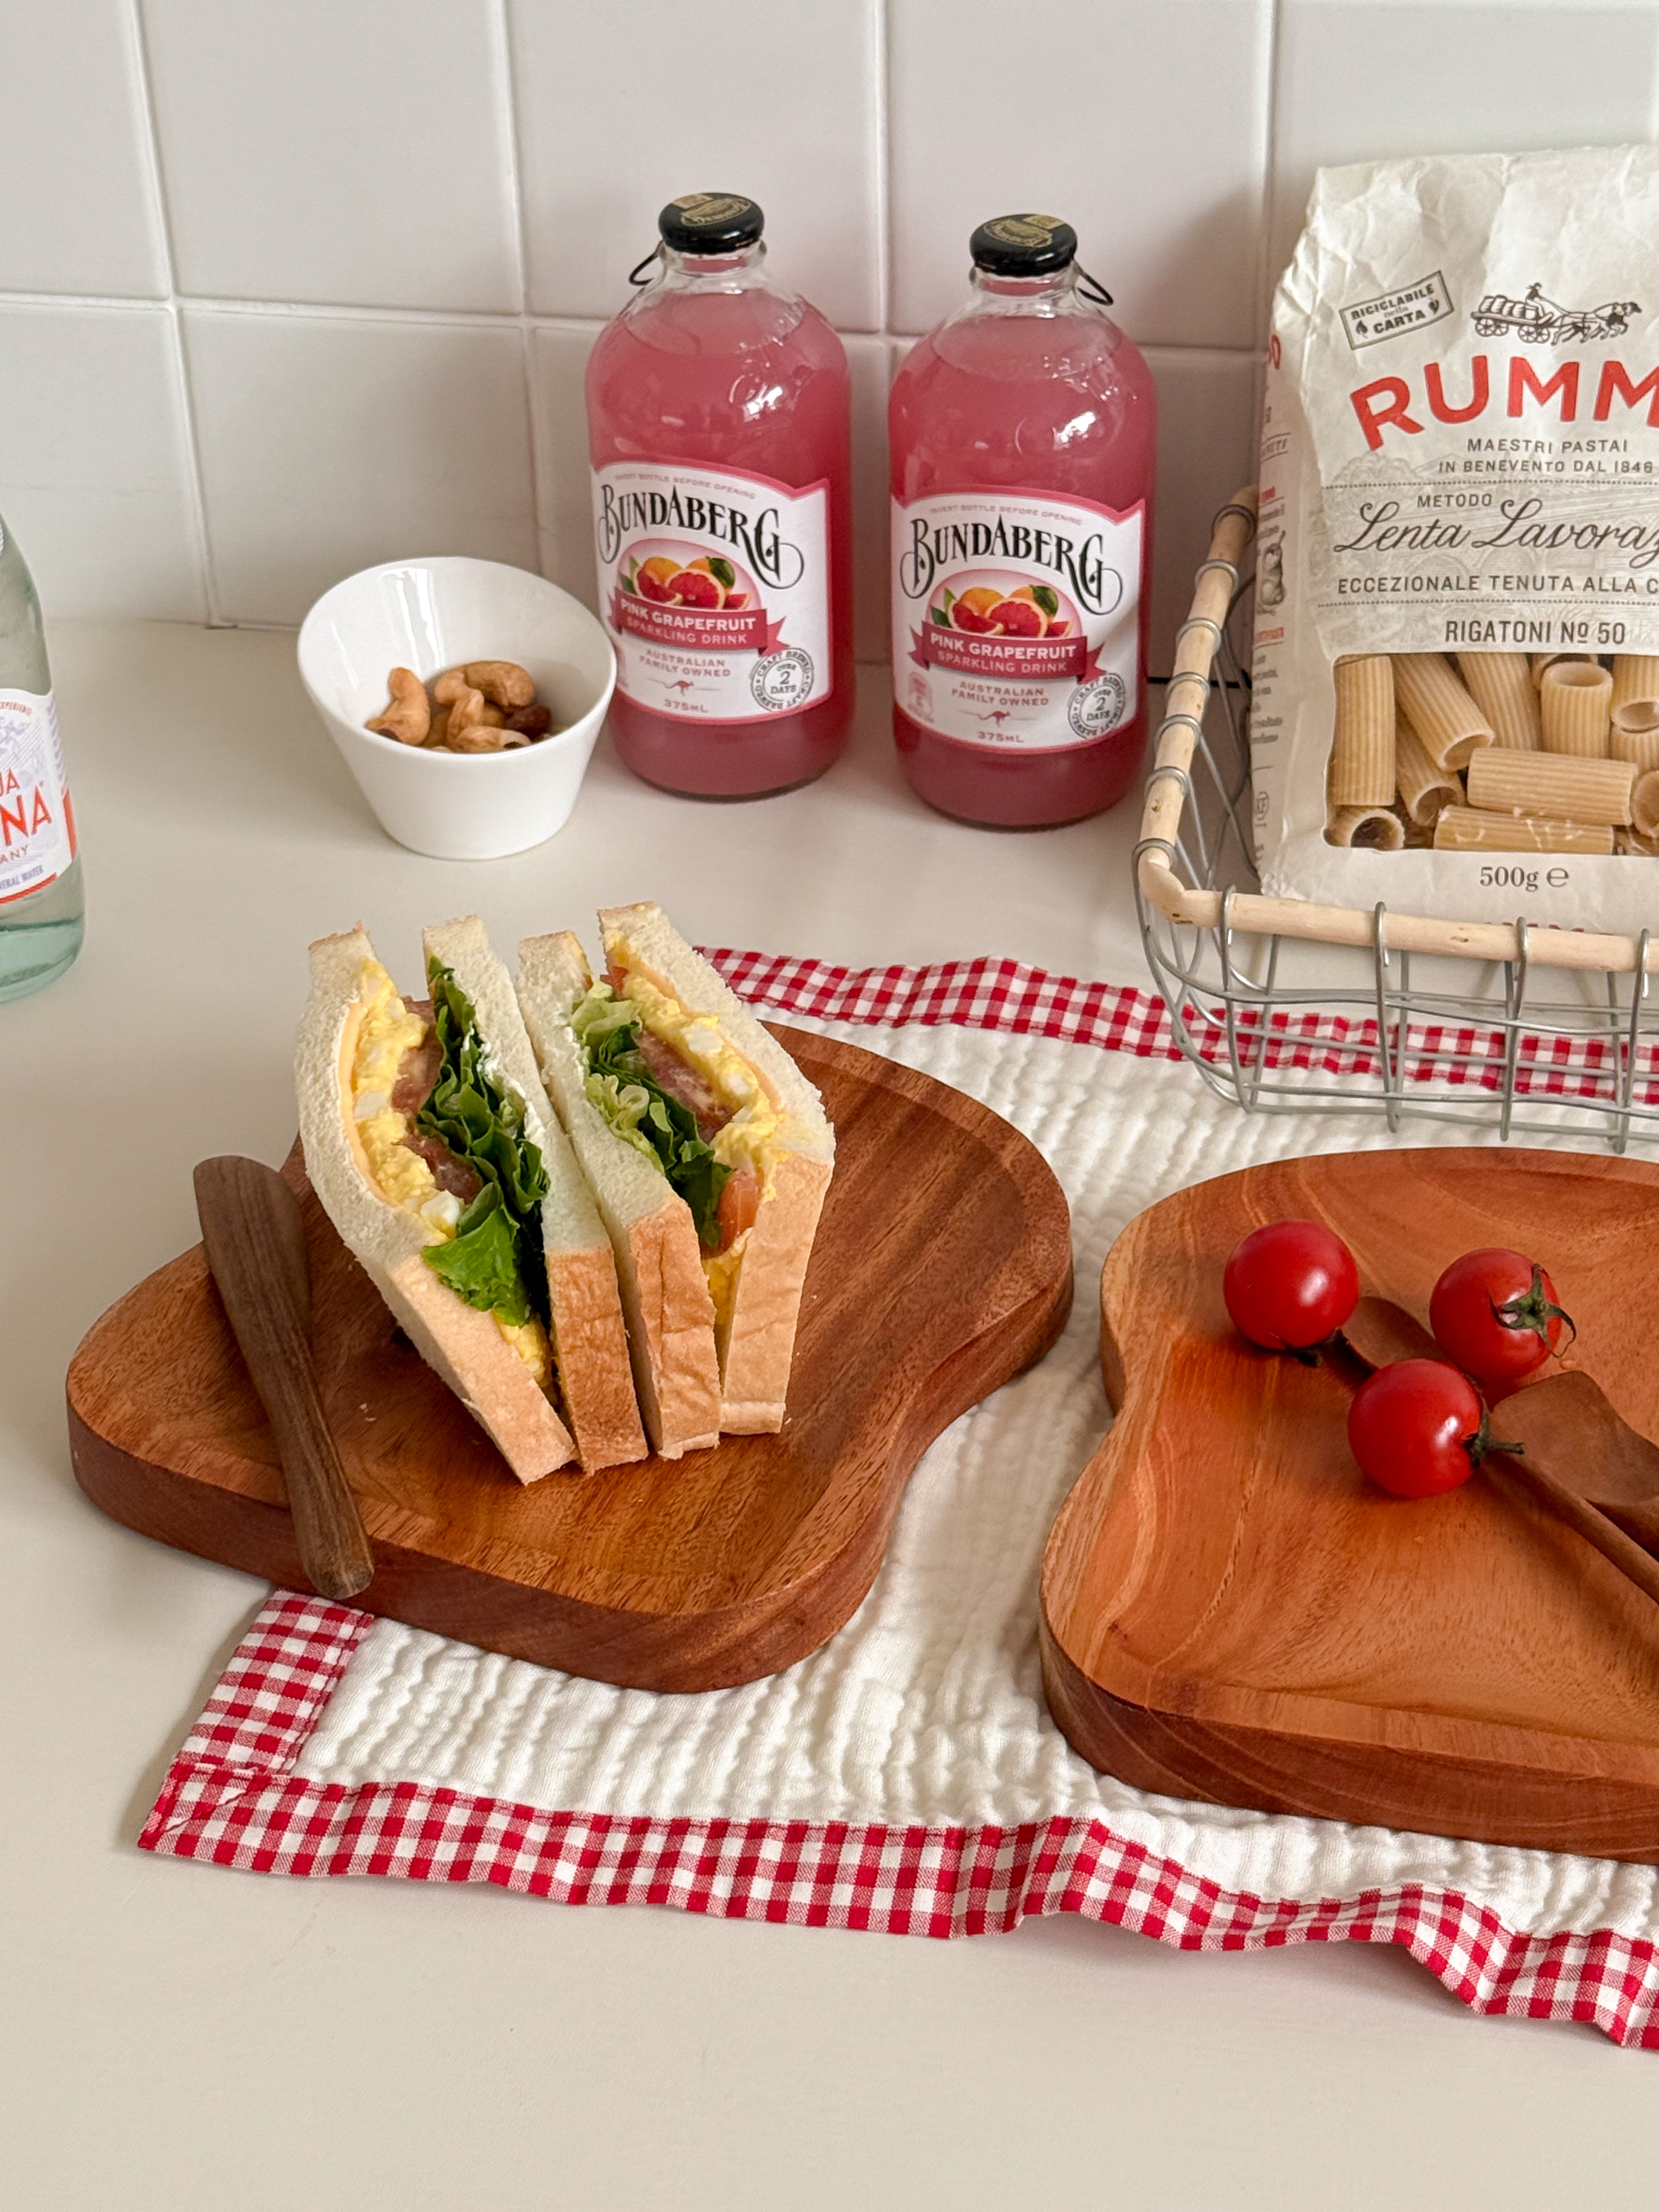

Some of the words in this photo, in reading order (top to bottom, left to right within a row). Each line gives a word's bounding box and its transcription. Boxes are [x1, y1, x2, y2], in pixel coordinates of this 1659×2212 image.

[1350, 283, 1435, 320] RICICLABILE
[1384, 306, 1409, 318] nella
[1373, 309, 1426, 334] CARTA
[1350, 355, 1659, 452] RUMM
[1467, 438, 1552, 455] MAESTRI
[1561, 439, 1628, 454] PASTAI
[1438, 460, 1455, 473] IN
[1464, 460, 1565, 473] BENEVENTO
[1573, 460, 1606, 473] DAL
[1615, 461, 1654, 474] 1846
[673, 477, 712, 488] BEFORE
[714, 483, 756, 499] OPENING
[1417, 493, 1492, 508] METODO
[961, 504, 996, 512] BOTTLE
[999, 505, 1040, 516] BEFORE
[1041, 511, 1082, 526] OPENING
[598, 484, 804, 589] BUNDABERG
[1333, 501, 1471, 552] Lenta
[900, 514, 1122, 616] BUNDABERG
[1338, 575, 1480, 594] ECCEZIONALE
[1488, 575, 1574, 592] TENUTA
[1583, 576, 1637, 593] ALLA
[620, 599, 648, 620] PINK
[652, 611, 756, 631] GRAPEFRUIT
[627, 617, 696, 643] SPARKLING
[701, 634, 747, 645] DRINK
[1445, 620, 1551, 644] RIGATONI
[1597, 622, 1626, 645] 50
[931, 633, 964, 652] PINK
[968, 642, 1076, 659] GRAPEFRUIT
[640, 656, 679, 673] FAMILY
[682, 667, 731, 676] OWNED
[646, 650, 725, 667] AUSTRALIAN
[938, 651, 1015, 673] SPARKLING
[1022, 662, 1067, 673] DRINK
[780, 670, 791, 685] 2
[960, 681, 1044, 696] AUSTRALIAN
[770, 685, 797, 694] DAYS
[951, 688, 995, 704] FAMILY
[999, 697, 1049, 706] OWNED
[1095, 697, 1105, 711] 2
[1479, 866, 1539, 892] 500g
